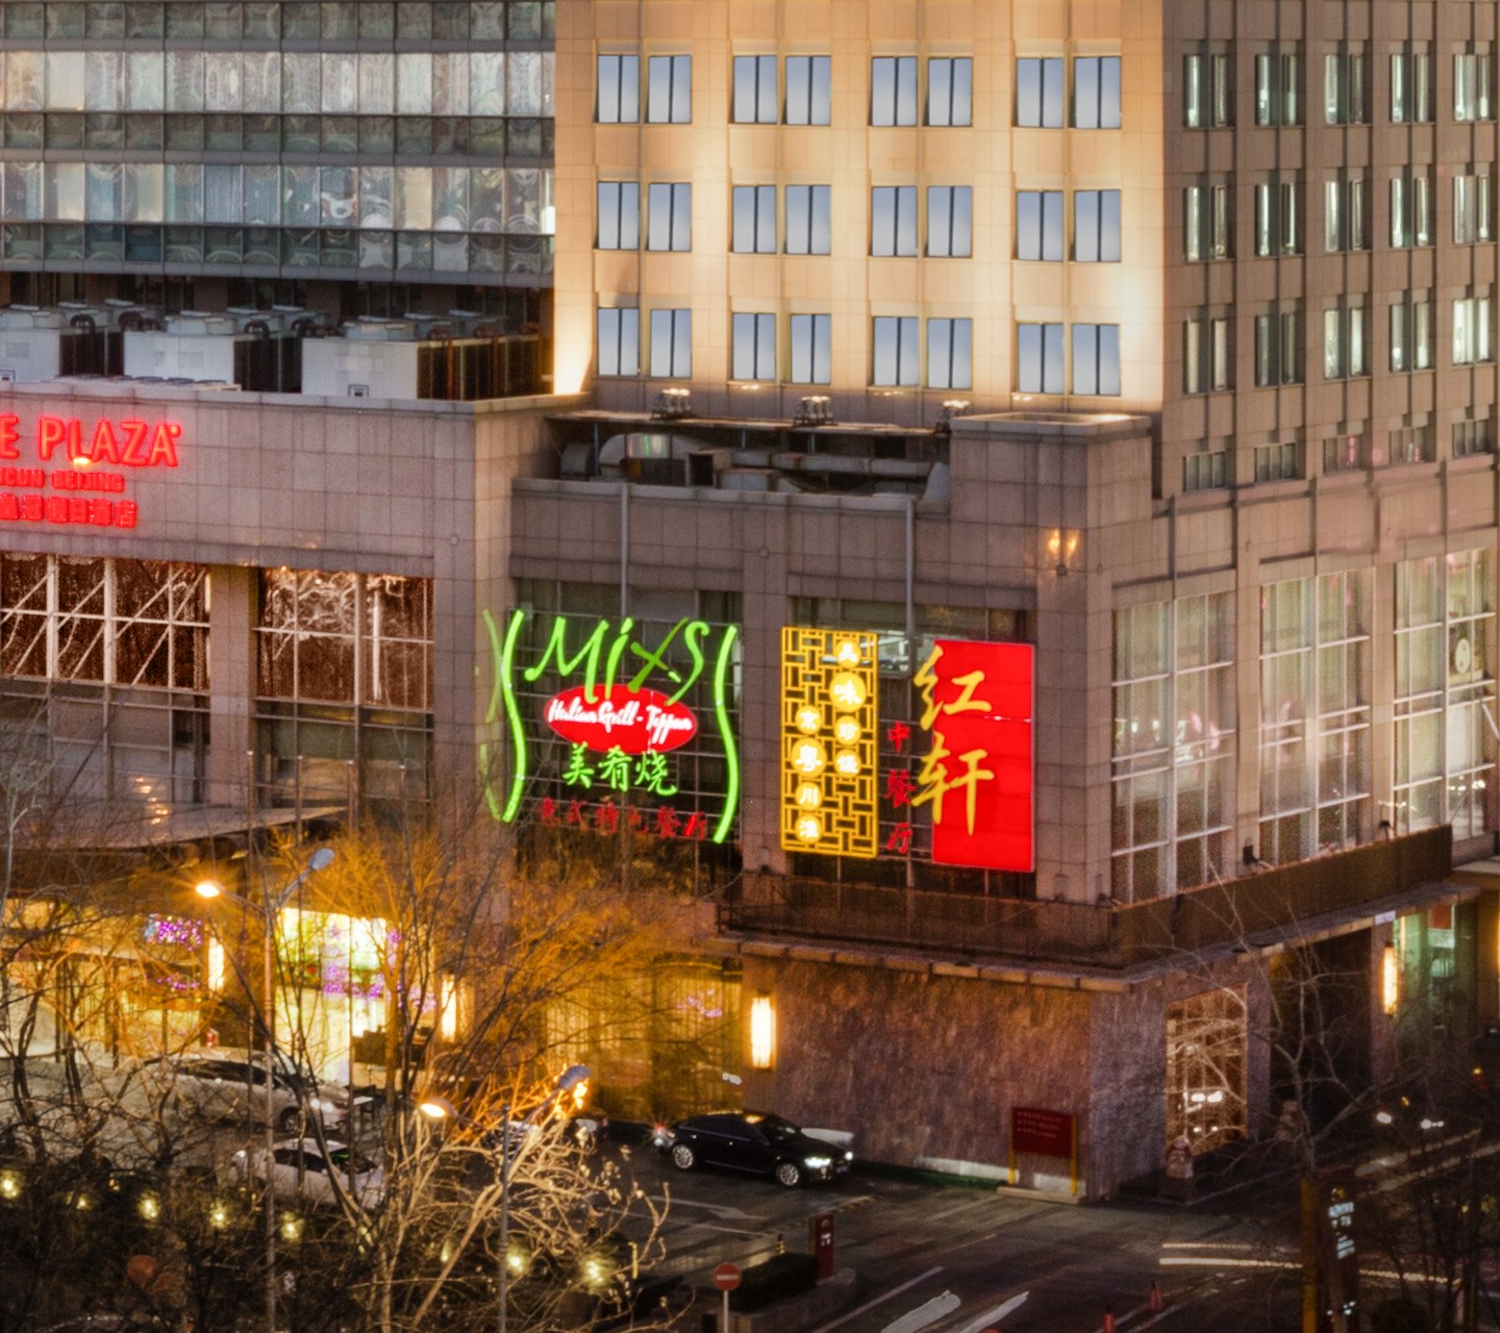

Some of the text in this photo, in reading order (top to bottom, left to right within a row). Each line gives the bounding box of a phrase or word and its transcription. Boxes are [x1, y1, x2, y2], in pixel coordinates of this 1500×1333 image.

[39, 416, 180, 467] PLAZA
[51, 470, 125, 493] BEIJING
[548, 697, 597, 724] Italian
[598, 701, 640, 733] Grill
[911, 645, 996, 837] 红轩
[563, 742, 677, 796] 美肴烧
